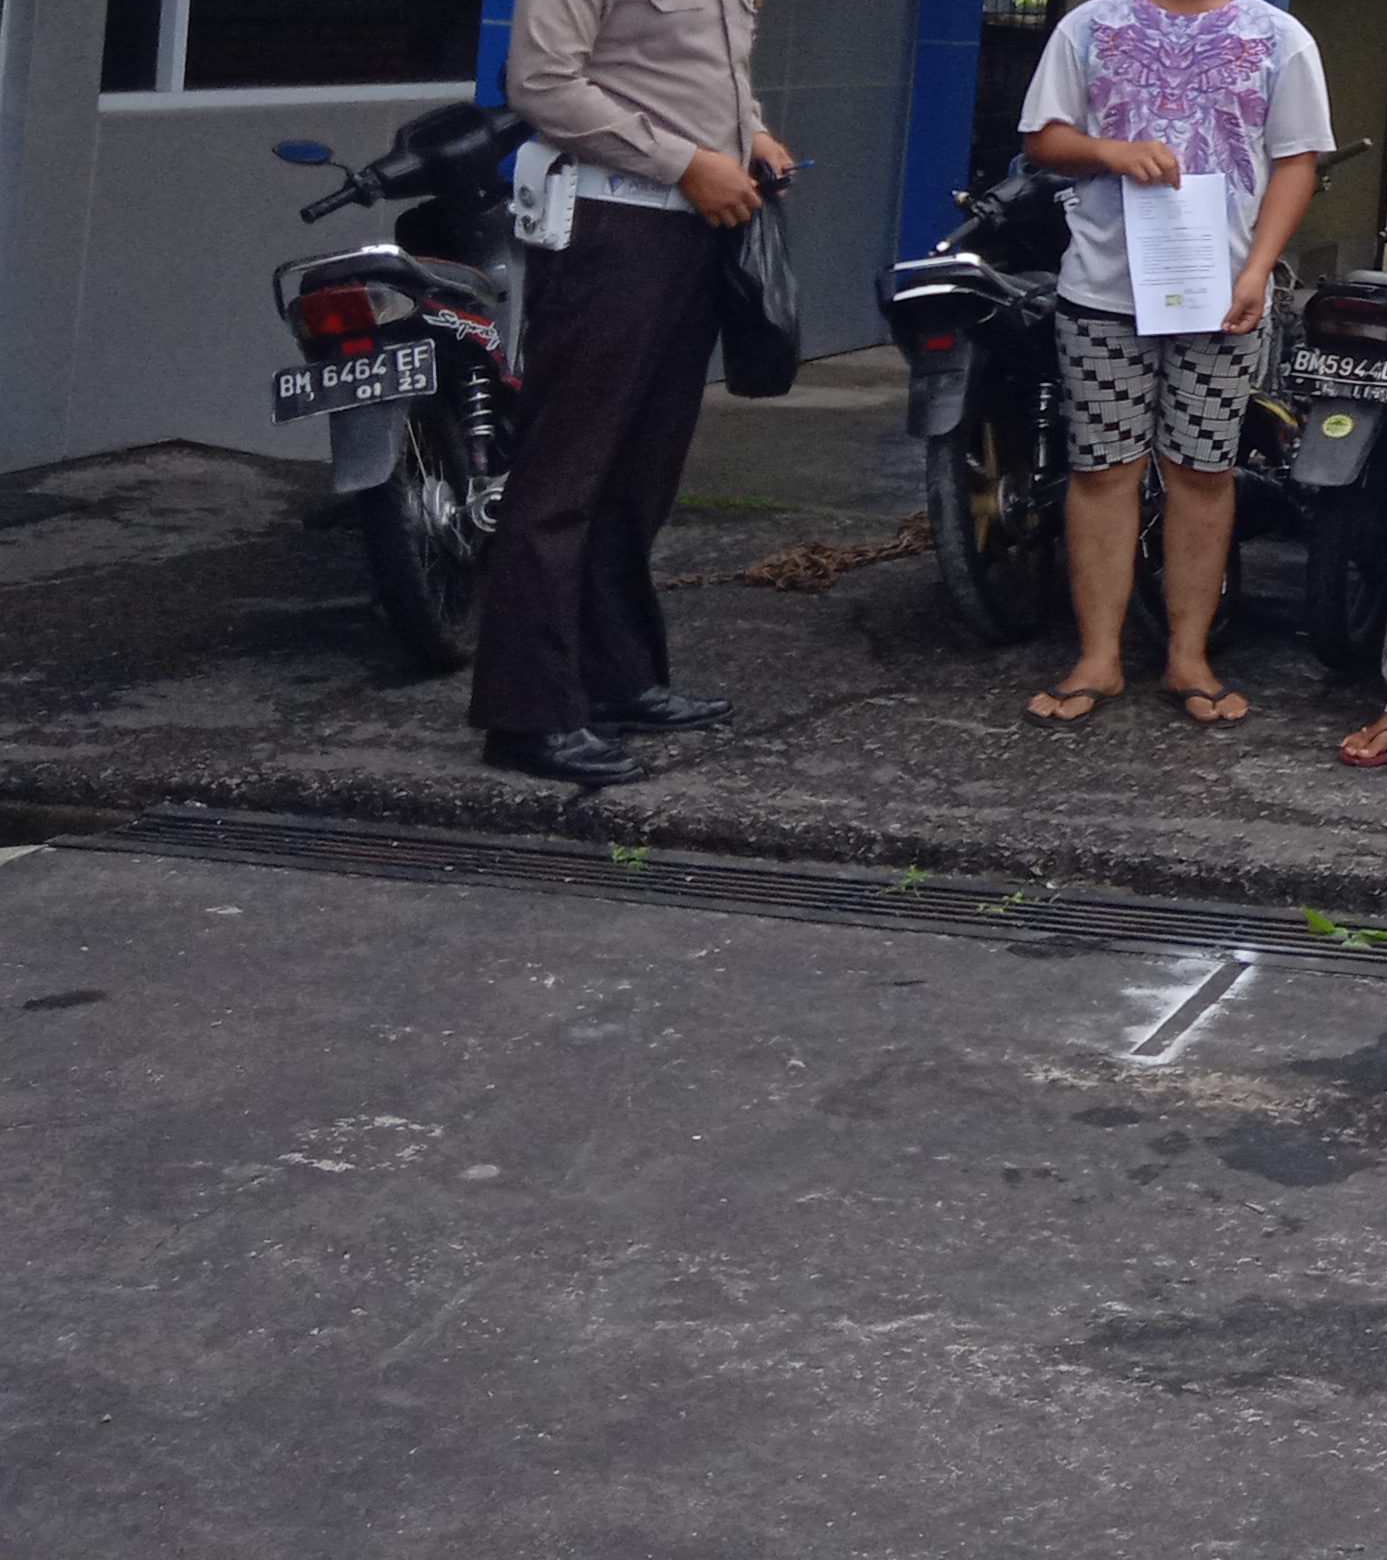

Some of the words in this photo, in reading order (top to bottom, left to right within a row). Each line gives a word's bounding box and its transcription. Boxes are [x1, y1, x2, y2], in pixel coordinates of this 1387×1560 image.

[279, 371, 313, 398] BM
[321, 353, 387, 389] 6464
[395, 345, 430, 371] EF
